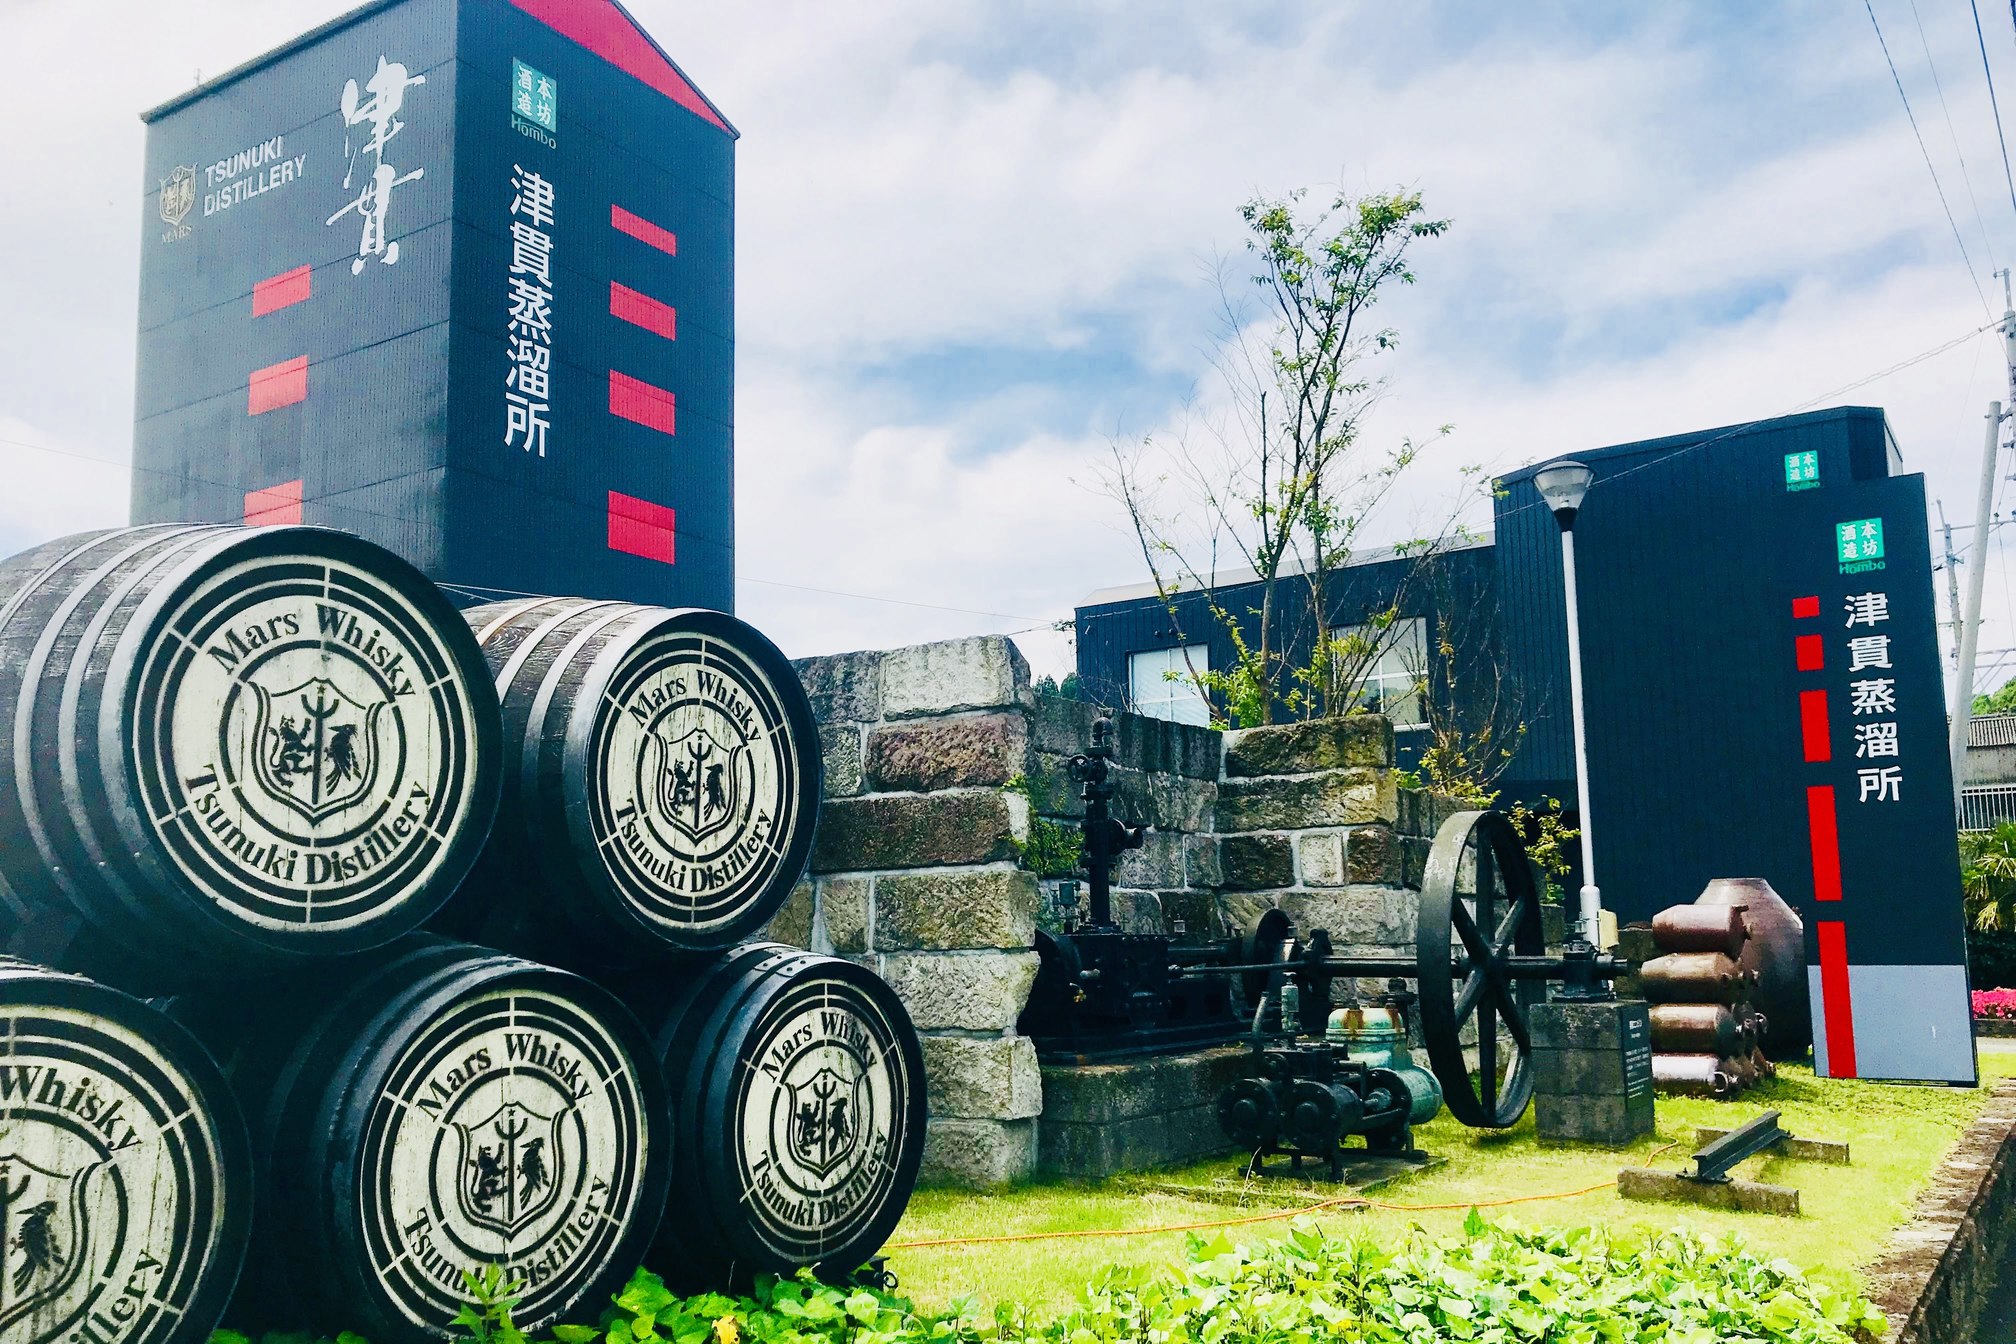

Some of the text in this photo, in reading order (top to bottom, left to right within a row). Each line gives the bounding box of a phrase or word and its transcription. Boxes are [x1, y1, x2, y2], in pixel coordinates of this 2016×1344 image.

[517, 64, 533, 117] 酒造
[537, 76, 553, 125] 本坊
[204, 135, 282, 188] TSUNUKI
[511, 113, 557, 150] Hombo
[203, 152, 307, 217] DISTILLERY
[161, 224, 193, 245] MARS
[503, 162, 556, 459] 津貫蒸溜所
[1789, 455, 1802, 481] 酒造
[1803, 452, 1816, 479] 本坊
[1839, 560, 1887, 575] Hombo
[1841, 524, 1859, 559] 酒造
[1860, 521, 1879, 557] 本坊
[207, 603, 417, 698] Mars Whisky
[628, 669, 762, 743] Mars Whisky
[1843, 591, 1903, 803] 津貫蒸溜所
[185, 763, 432, 885] Tsunuki Distillery
[615, 799, 772, 893] Tsunuki Distillery
[415, 1033, 593, 1123] Mars Whisky
[761, 1011, 878, 1084] Mars Whisky
[0, 1064, 142, 1152] Whisky
[752, 1127, 889, 1227] Tsunuki Distillery
[402, 1174, 610, 1299] Tsunu Distillery
